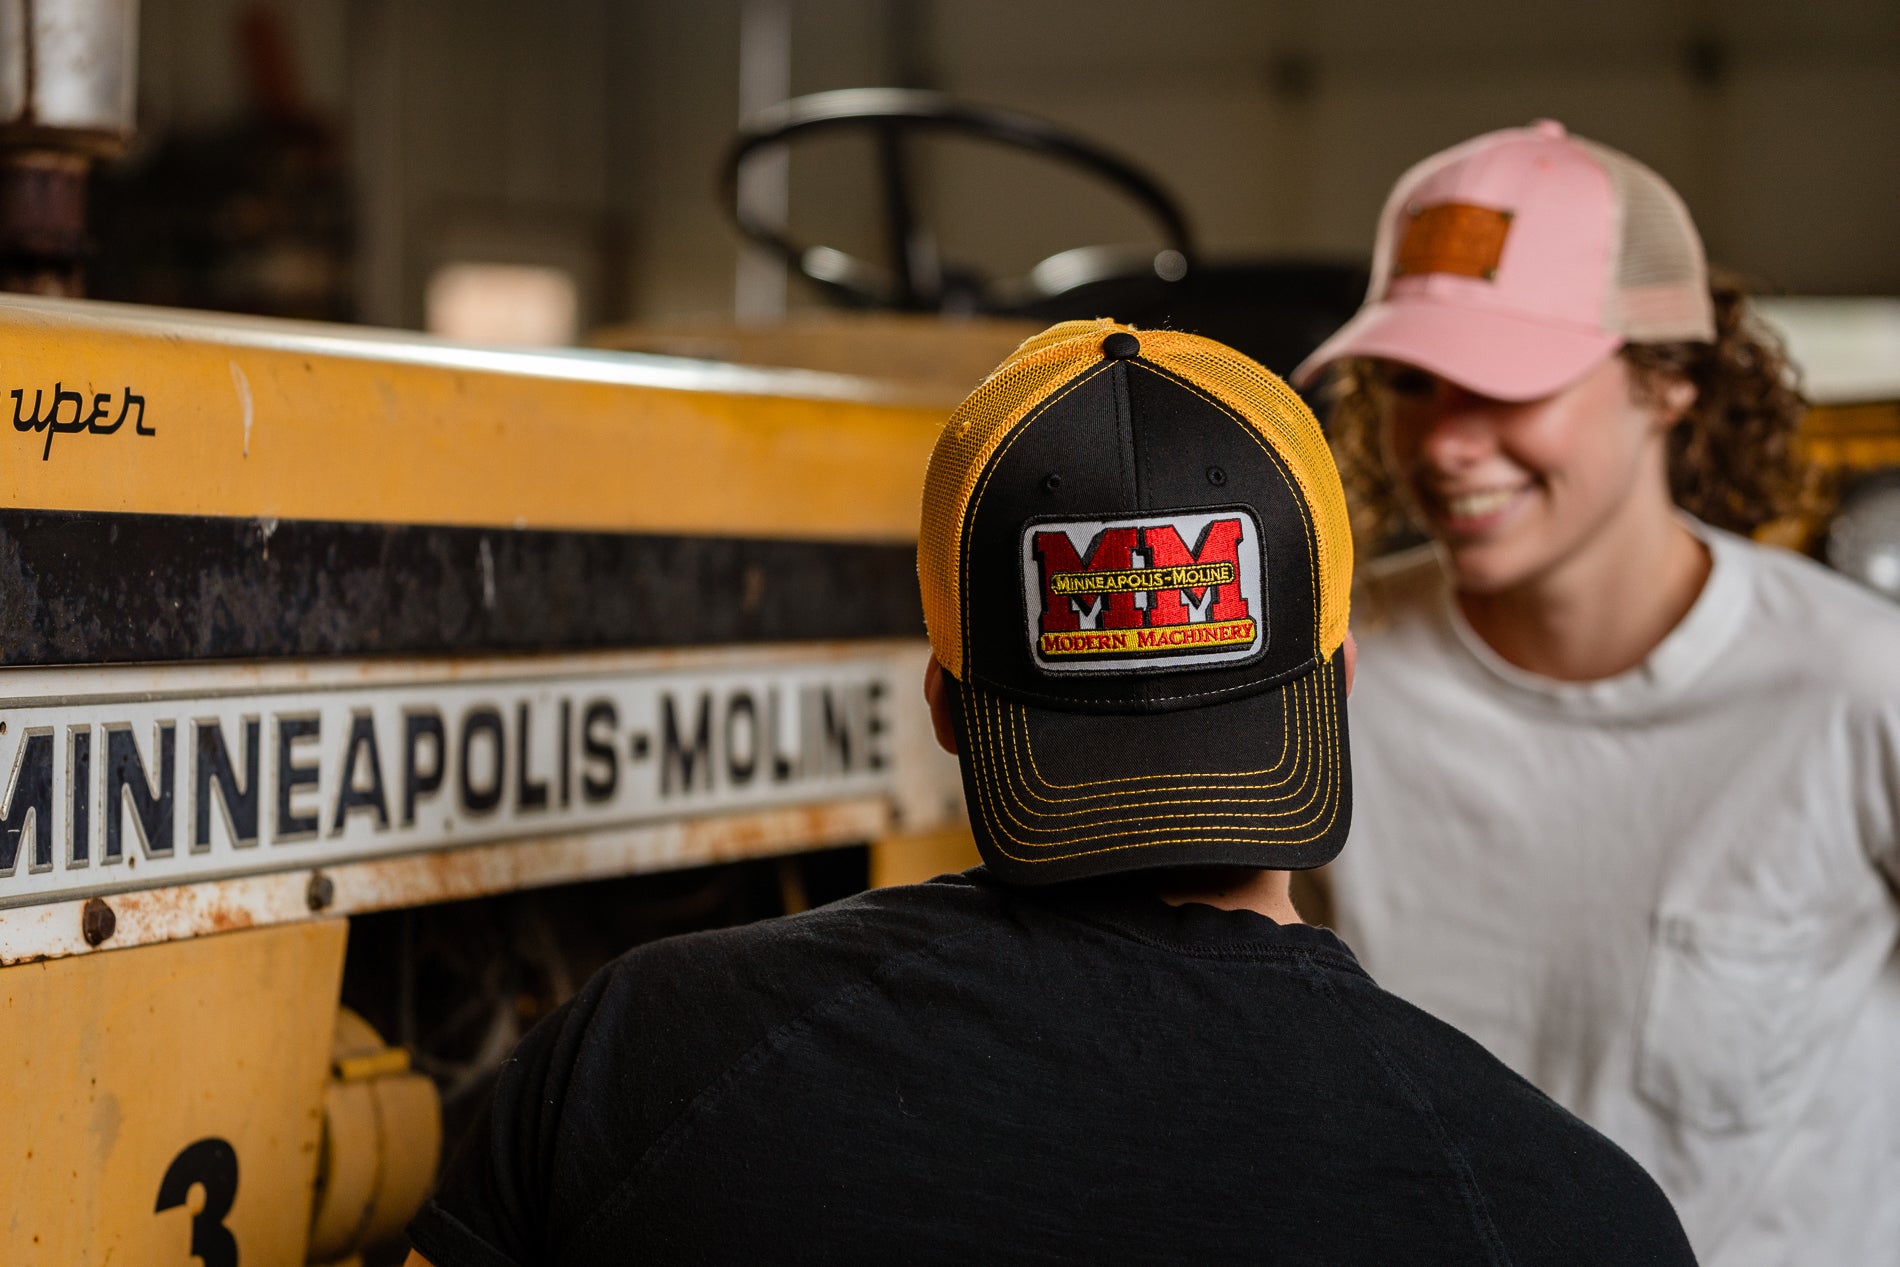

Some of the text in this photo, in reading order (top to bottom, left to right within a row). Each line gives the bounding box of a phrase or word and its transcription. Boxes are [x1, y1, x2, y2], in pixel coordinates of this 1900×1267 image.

[8, 381, 156, 461] uper
[1043, 622, 1253, 652] MODERN MACHINERY
